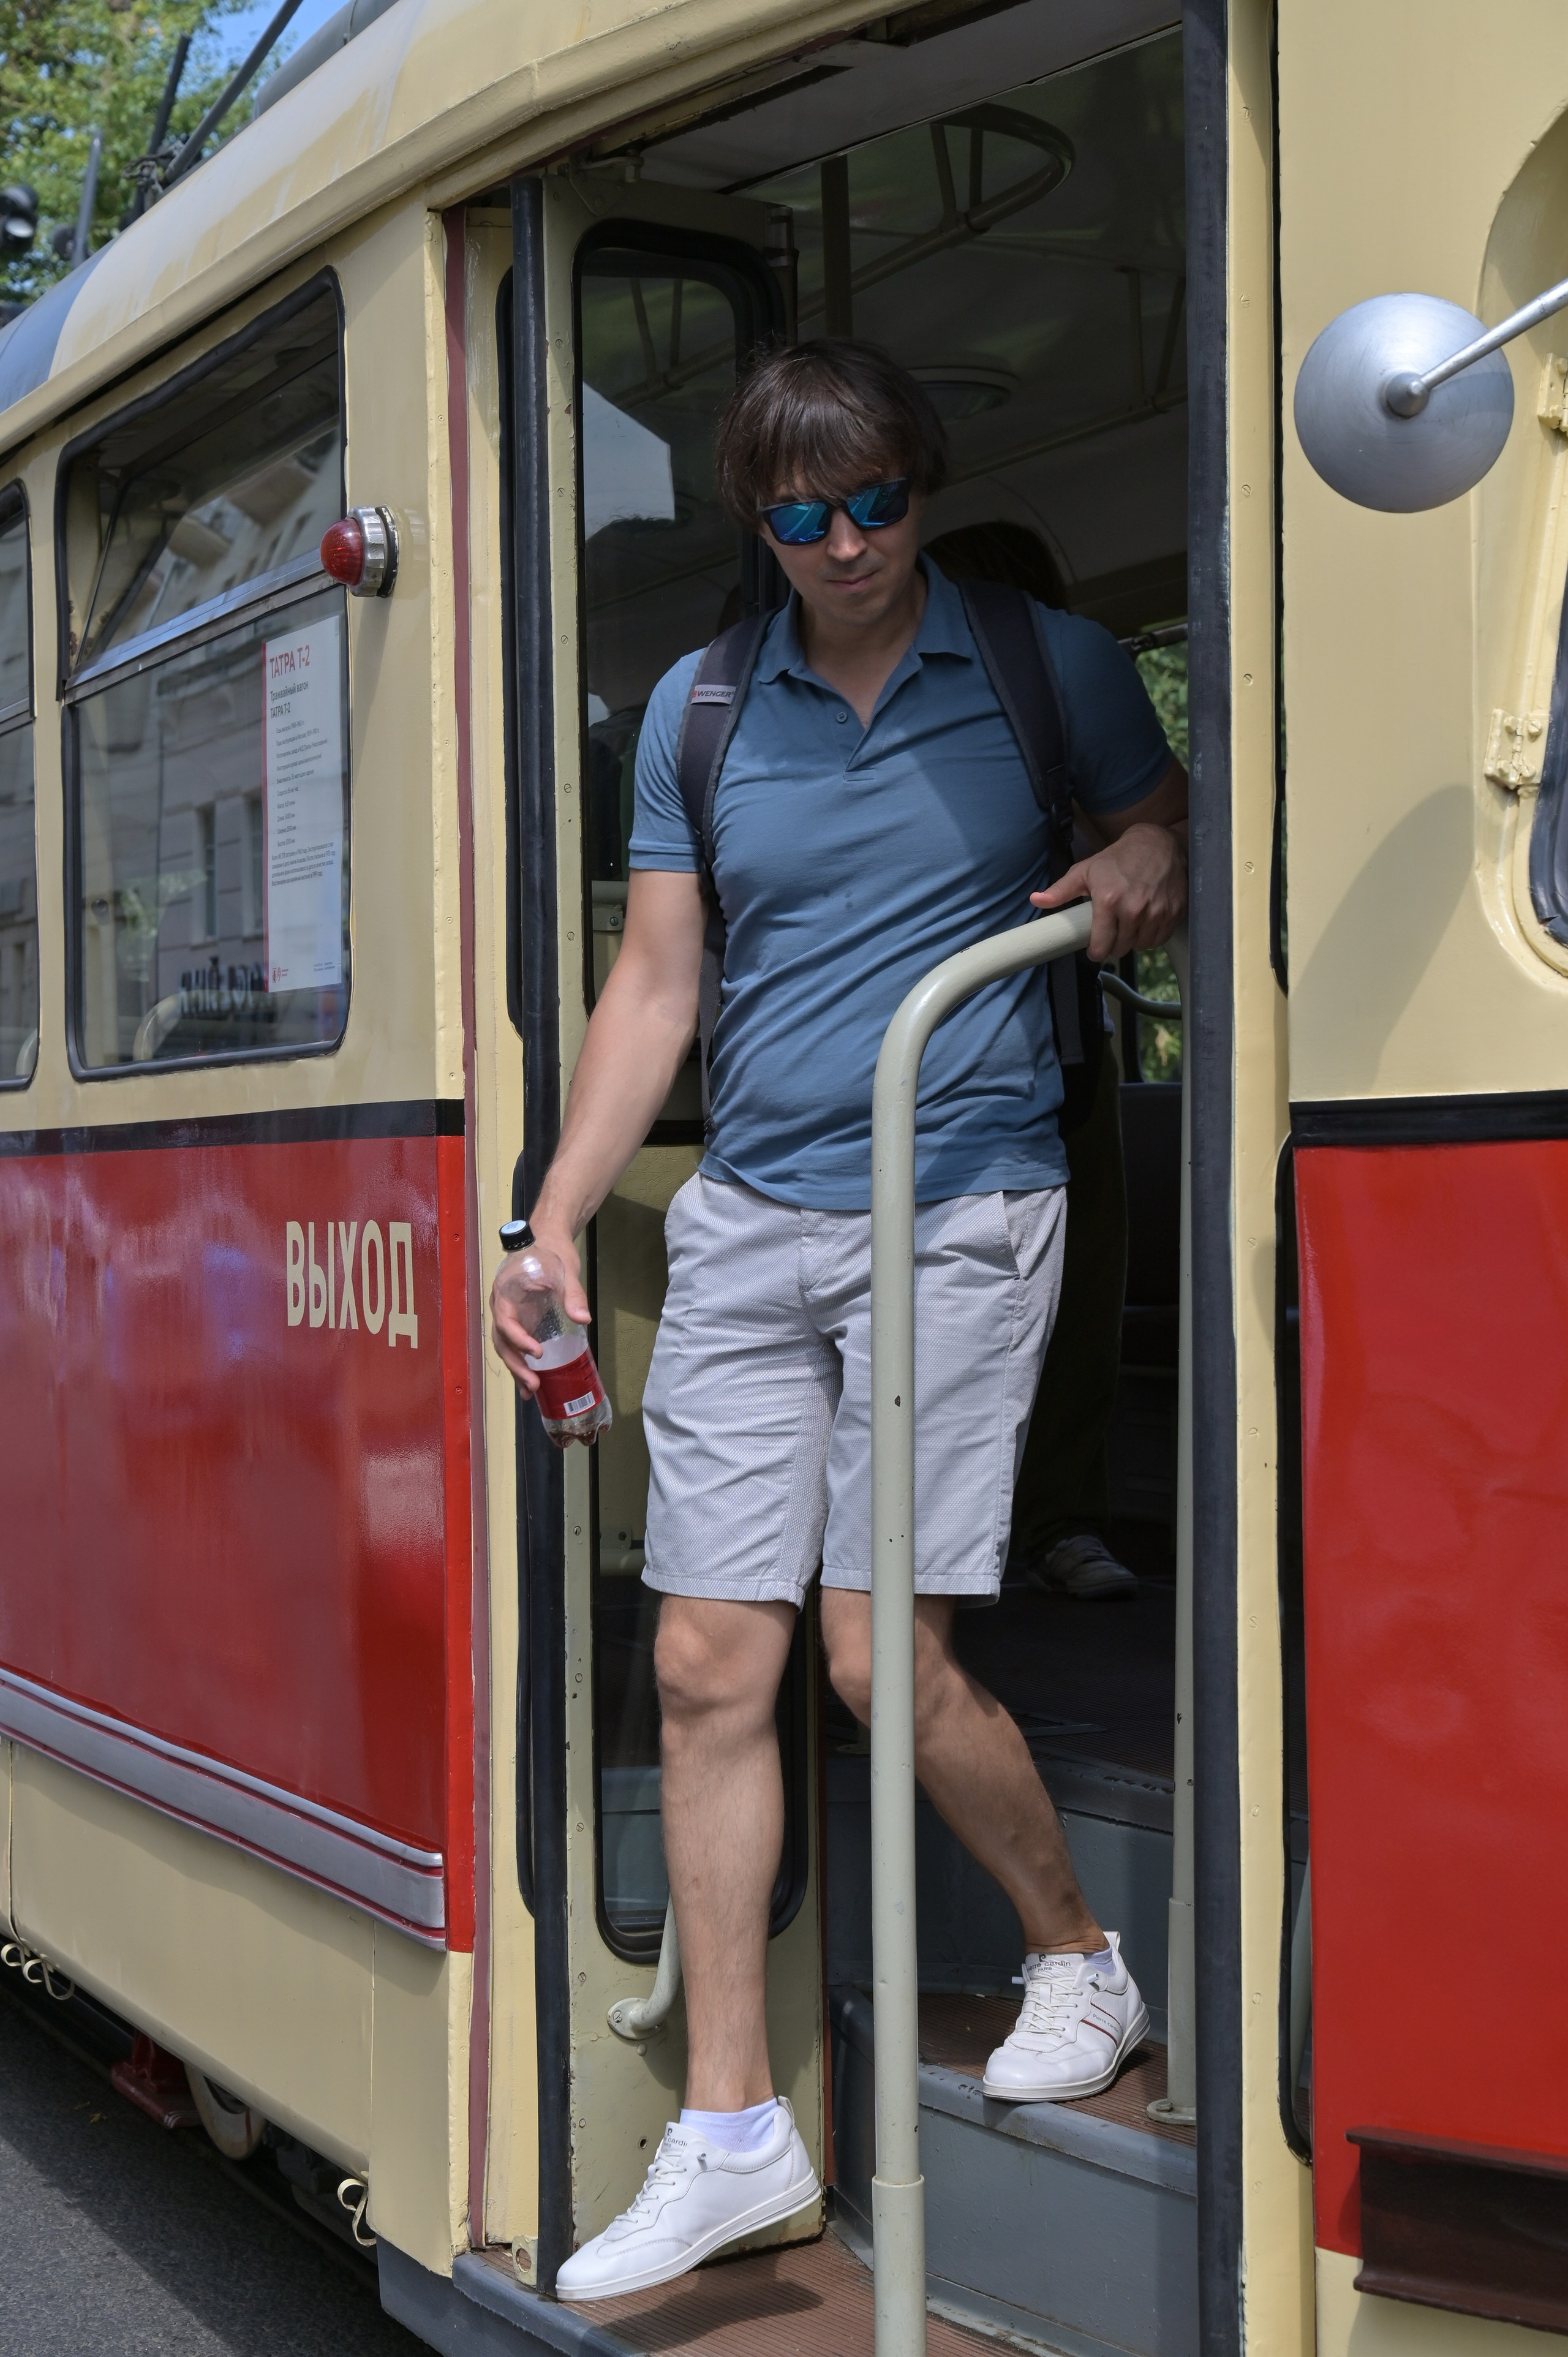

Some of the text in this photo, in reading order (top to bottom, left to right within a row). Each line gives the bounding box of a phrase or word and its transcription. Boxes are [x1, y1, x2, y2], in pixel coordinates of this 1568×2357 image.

[270, 644, 310, 679] ТАТРА Т-2
[270, 681, 309, 704] Трамвайный вагон
[270, 705, 284, 718] ТАТРА
[286, 1220, 418, 1349] ВЫХОД
